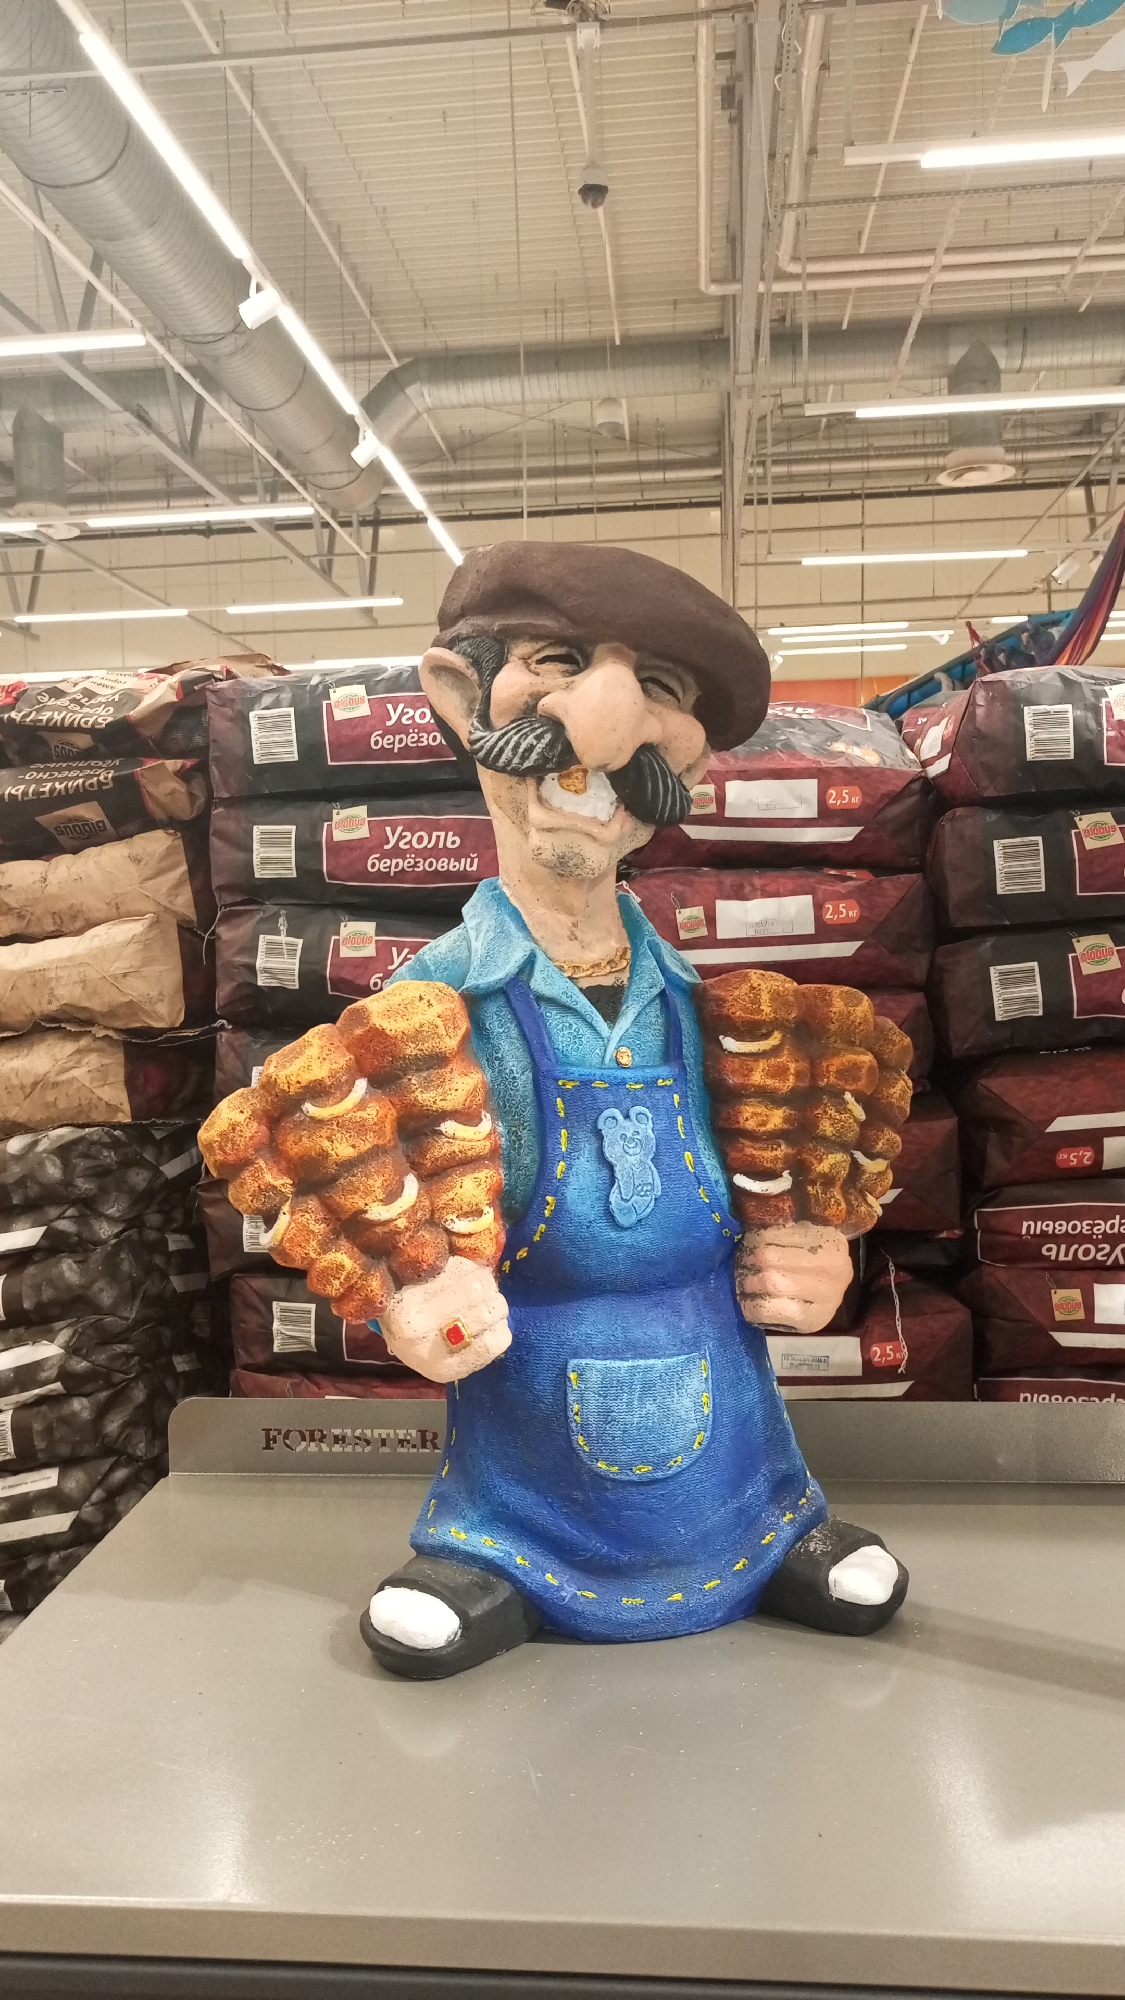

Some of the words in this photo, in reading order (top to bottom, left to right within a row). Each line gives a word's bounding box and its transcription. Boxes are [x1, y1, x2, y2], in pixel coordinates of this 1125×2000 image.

[385, 703, 436, 727] Уго
[4, 774, 115, 803] БРИКЕТЫ
[828, 789, 849, 805] 2,5
[383, 825, 462, 850] Уголь
[366, 853, 479, 877] берёзовый
[825, 903, 847, 921] 2,5
[848, 909, 859, 918] кг
[1069, 1150, 1092, 1166] 2,5
[871, 1345, 894, 1363] 2,5
[261, 1427, 442, 1453] FORESTER
